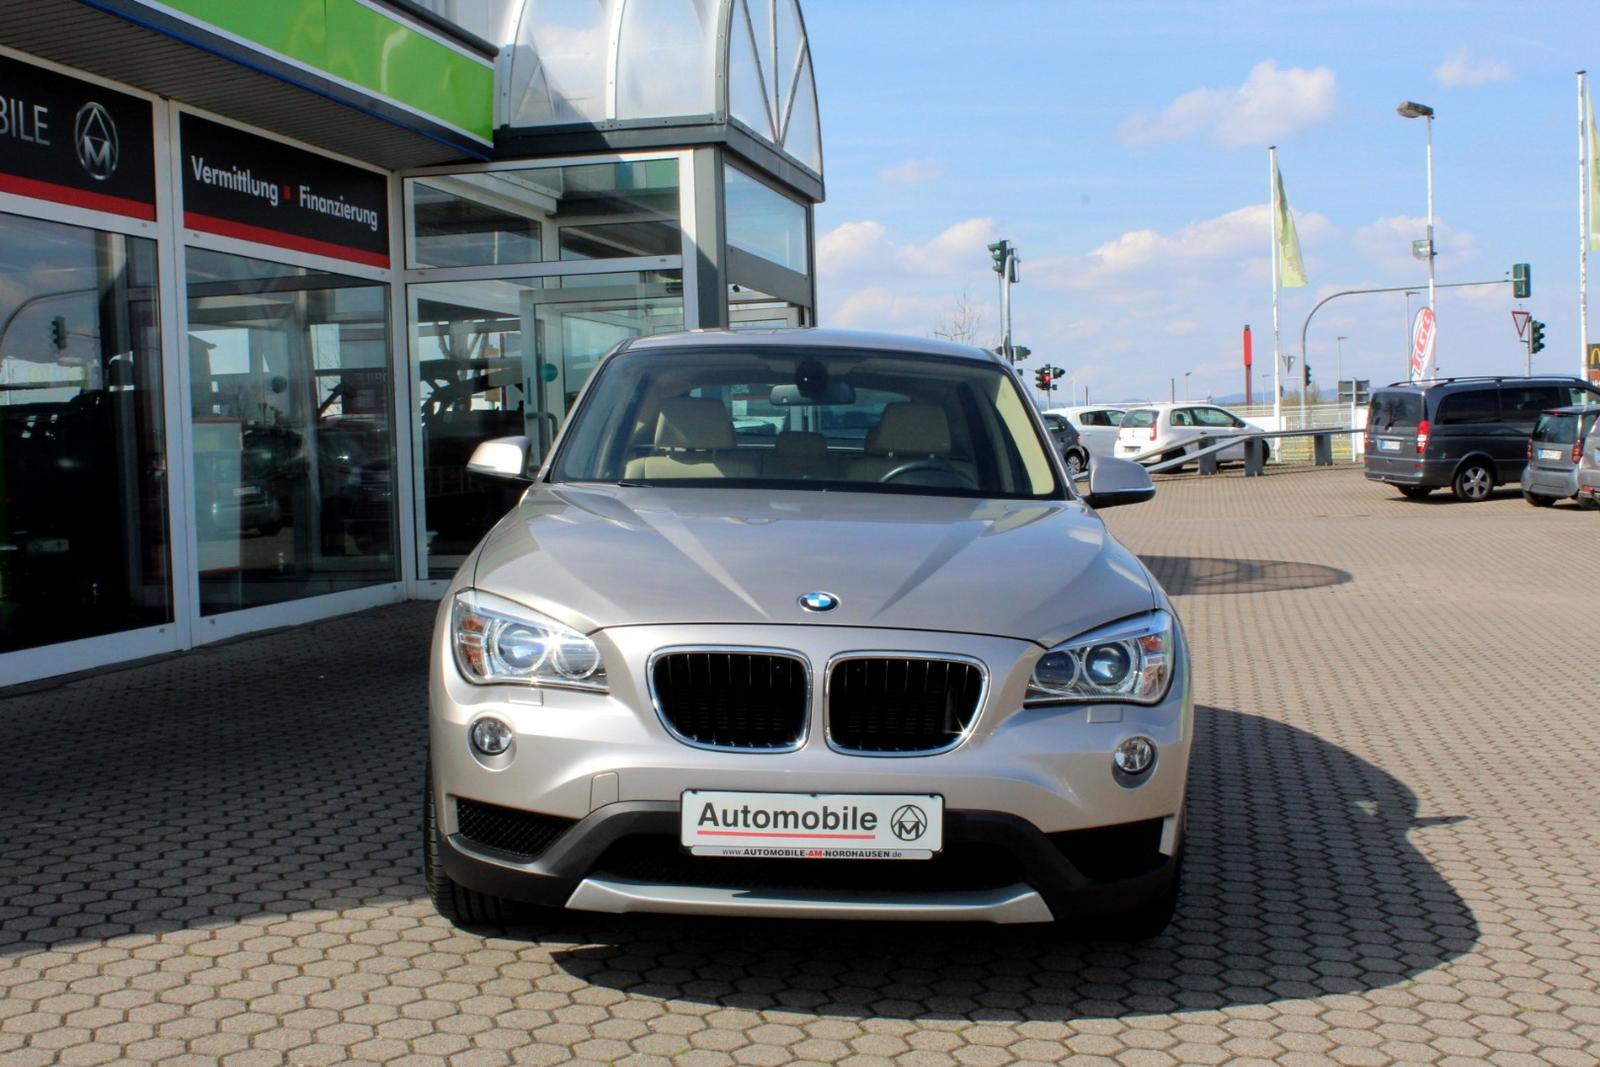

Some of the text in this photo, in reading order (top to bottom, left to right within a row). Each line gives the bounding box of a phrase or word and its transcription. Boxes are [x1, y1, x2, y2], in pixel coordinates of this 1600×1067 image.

[191, 155, 378, 231] Vermittlung Finanzierung
[697, 802, 878, 831] Automobile
